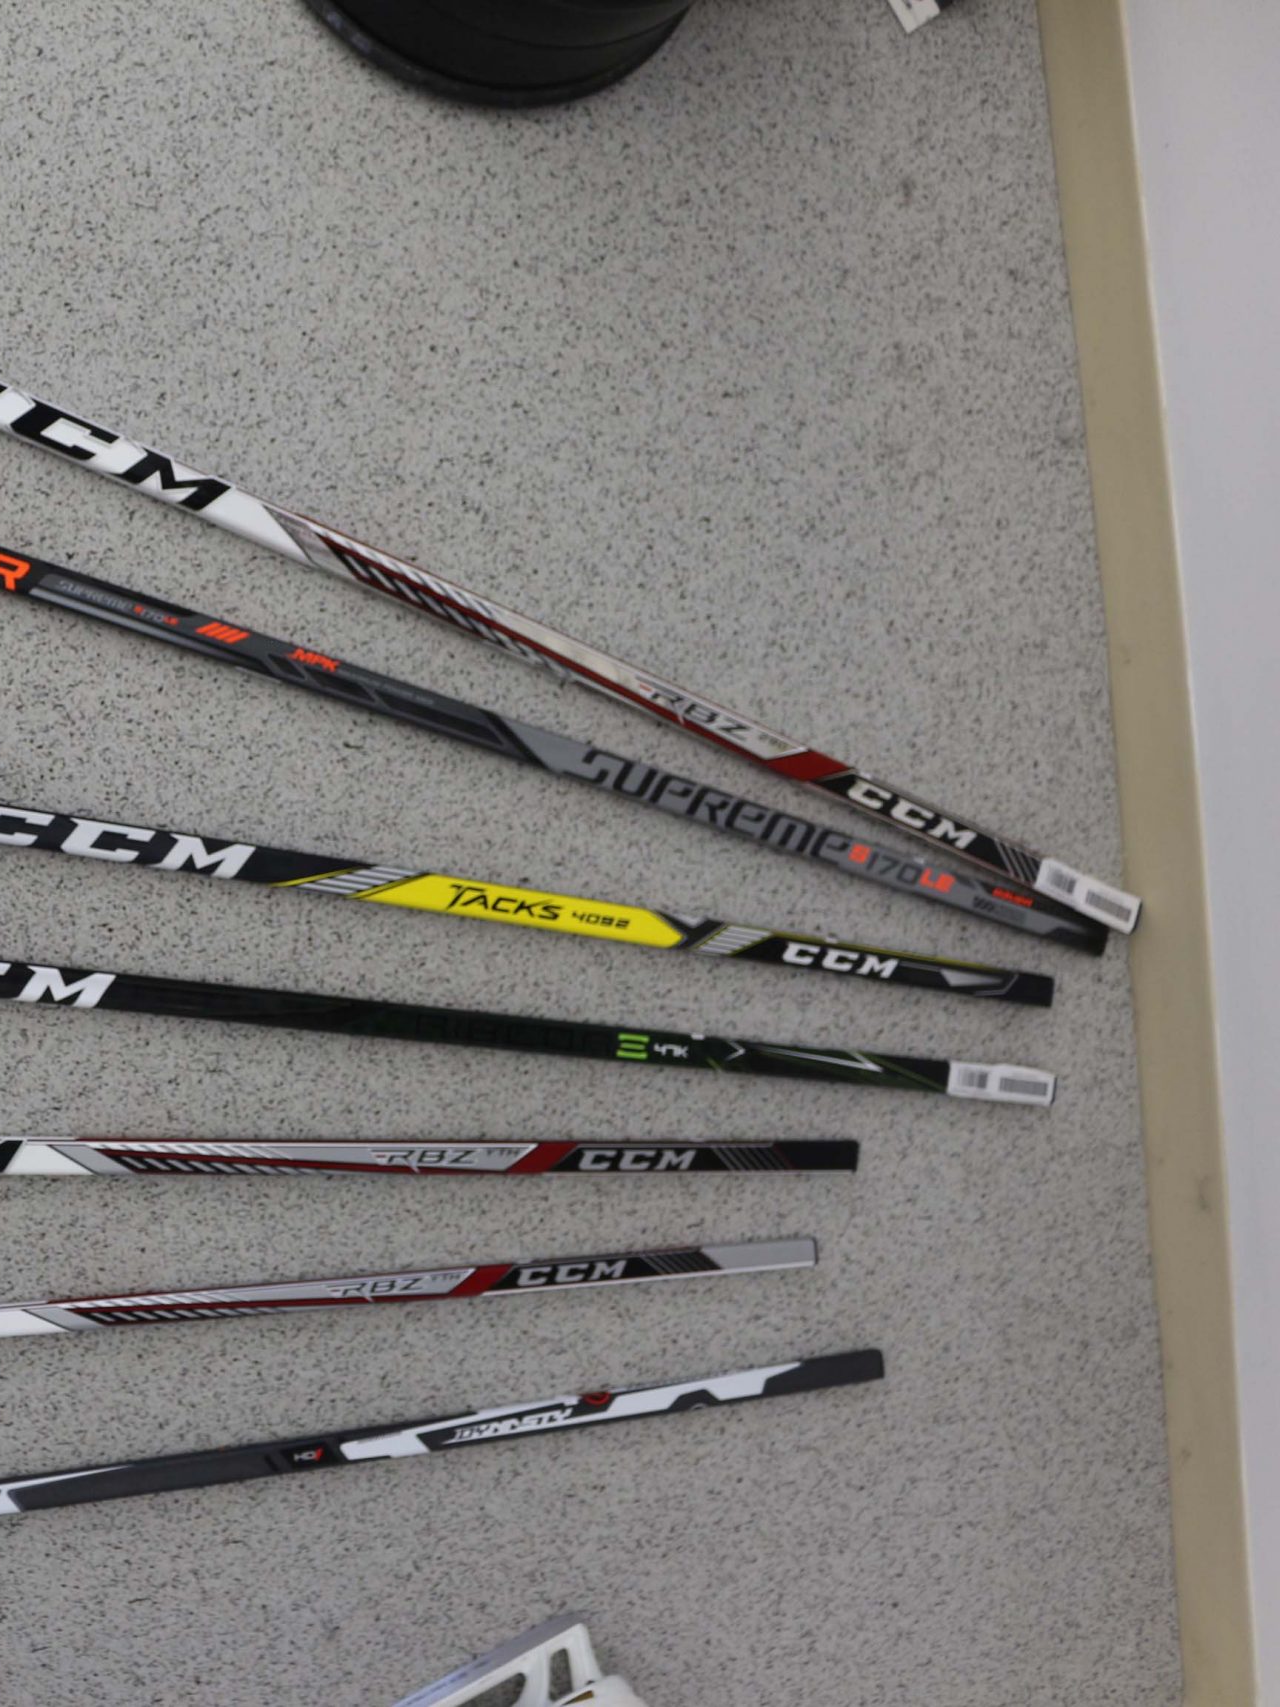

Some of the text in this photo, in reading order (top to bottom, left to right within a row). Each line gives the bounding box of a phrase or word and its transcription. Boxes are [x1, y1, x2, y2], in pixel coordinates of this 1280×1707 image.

[847, 780, 978, 850] CCM
[448, 884, 562, 921] TACKS
[782, 942, 900, 979] CCM
[578, 1149, 696, 1171] CCM
[517, 1260, 627, 1287] CCM
